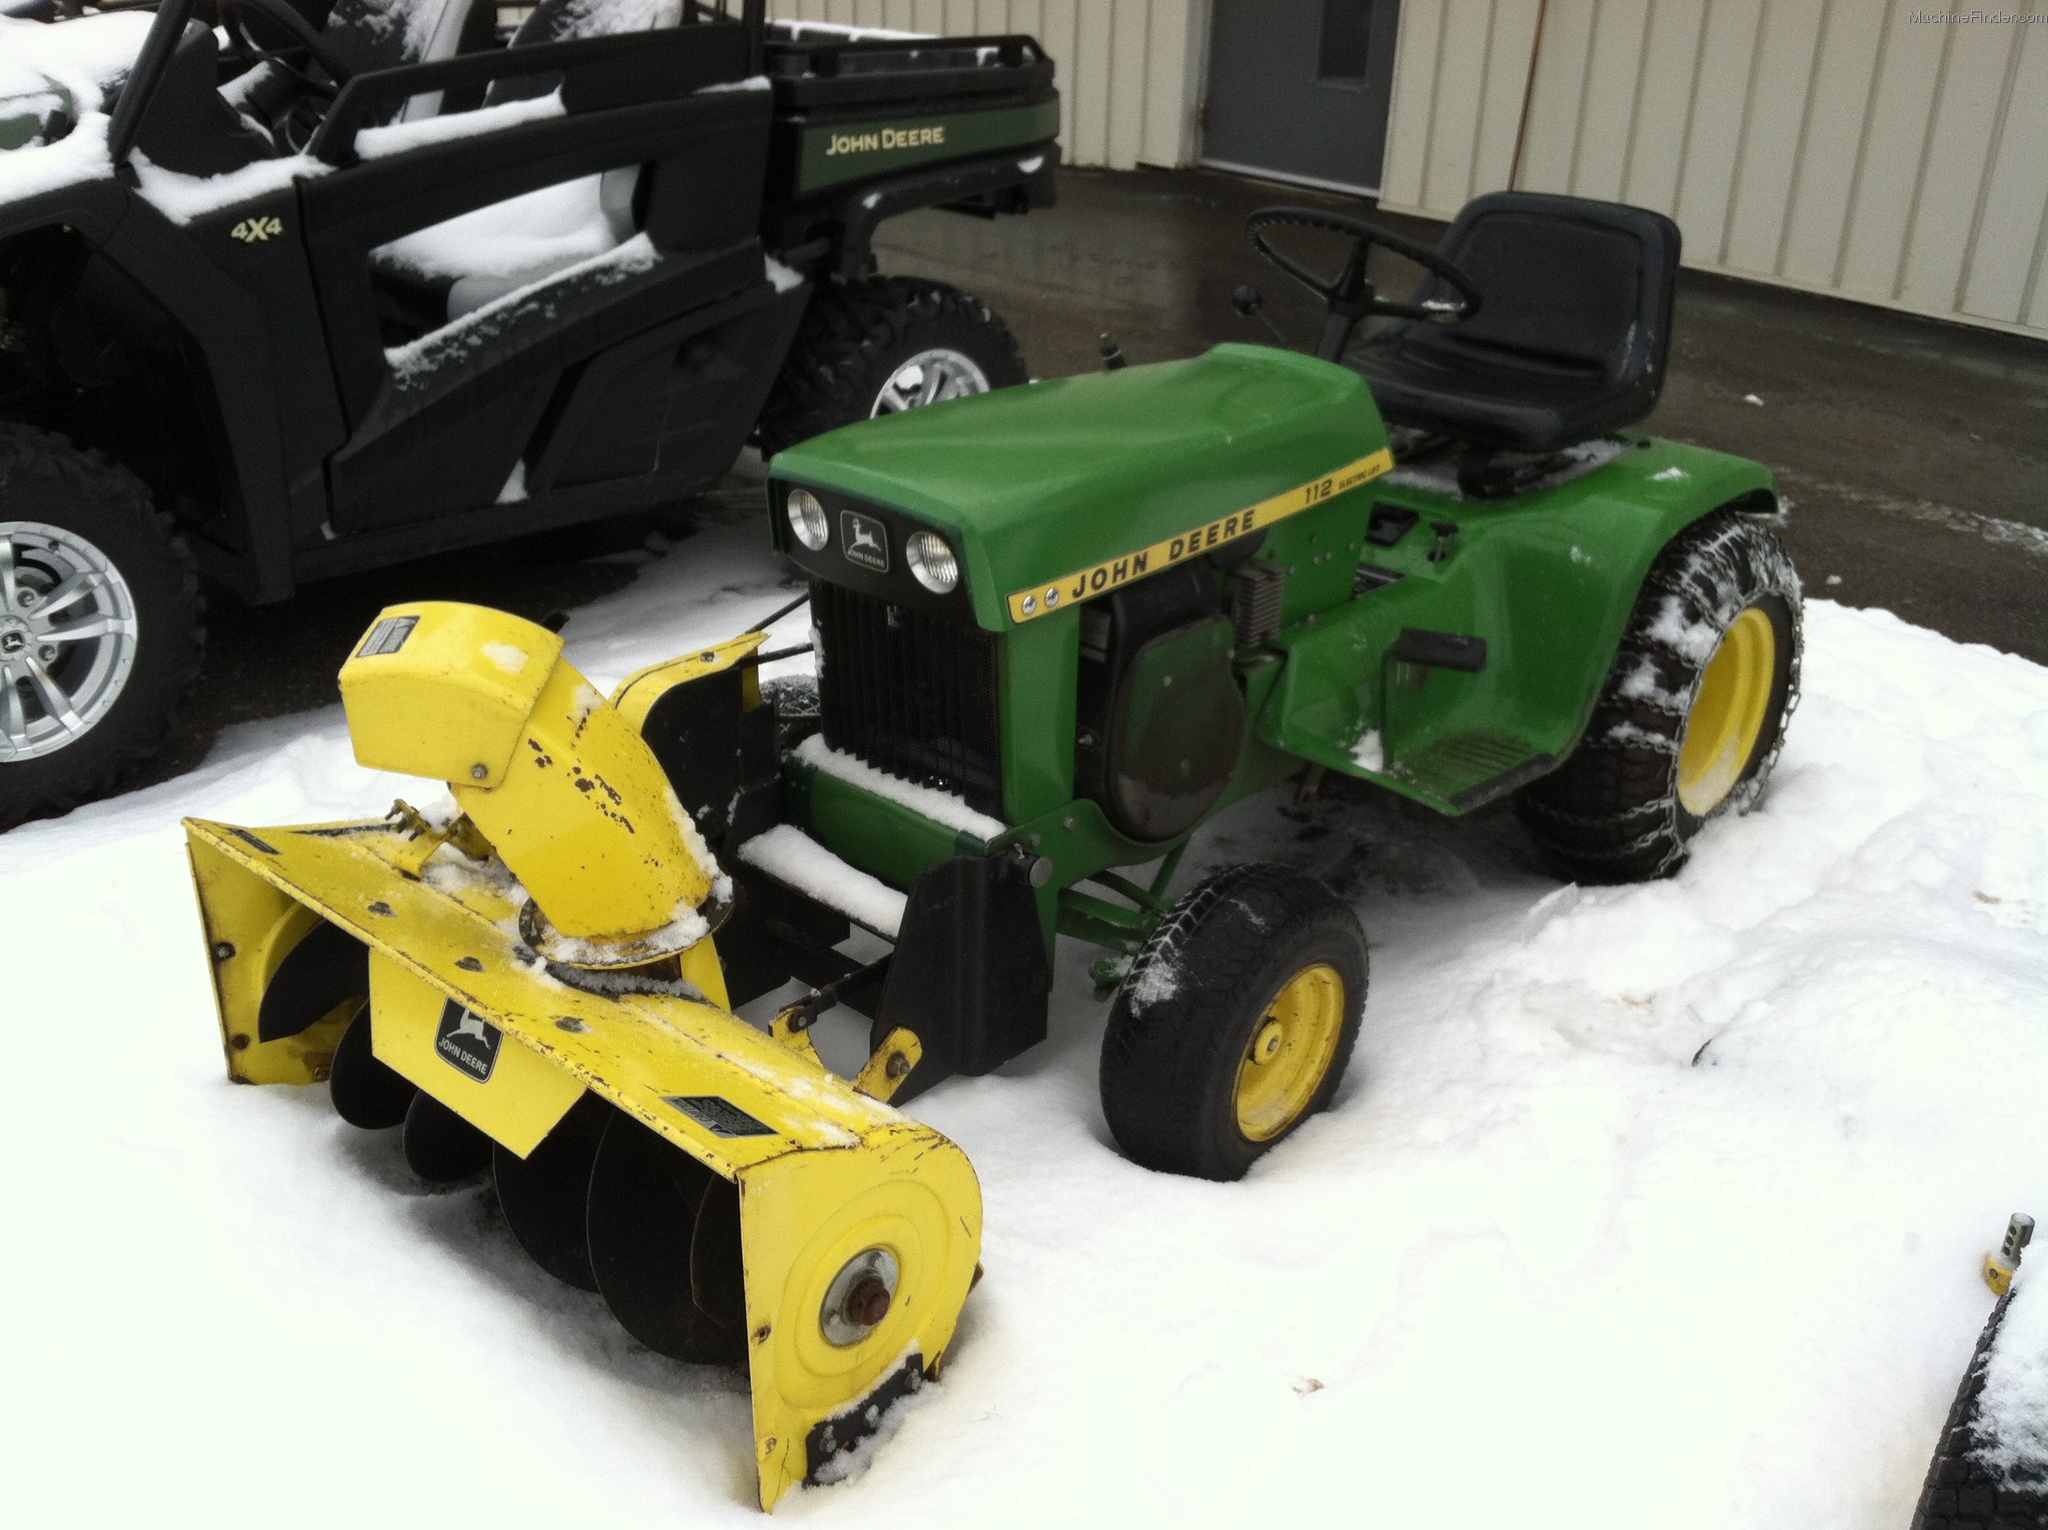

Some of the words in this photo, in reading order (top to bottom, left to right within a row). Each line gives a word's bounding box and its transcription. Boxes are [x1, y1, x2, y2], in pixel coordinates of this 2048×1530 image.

[826, 132, 878, 155] JOHN
[881, 127, 945, 149] DEERE
[230, 216, 283, 243] 4X4
[1071, 551, 1149, 598] JOHN
[1168, 509, 1256, 561] DEERE
[1305, 478, 1333, 505] 112
[1338, 469, 1367, 490] ELECTRIC
[847, 549, 864, 560] JOHN
[864, 553, 885, 568] DEERE
[438, 1037, 462, 1058] JOHN
[460, 1050, 488, 1075] DEERE
